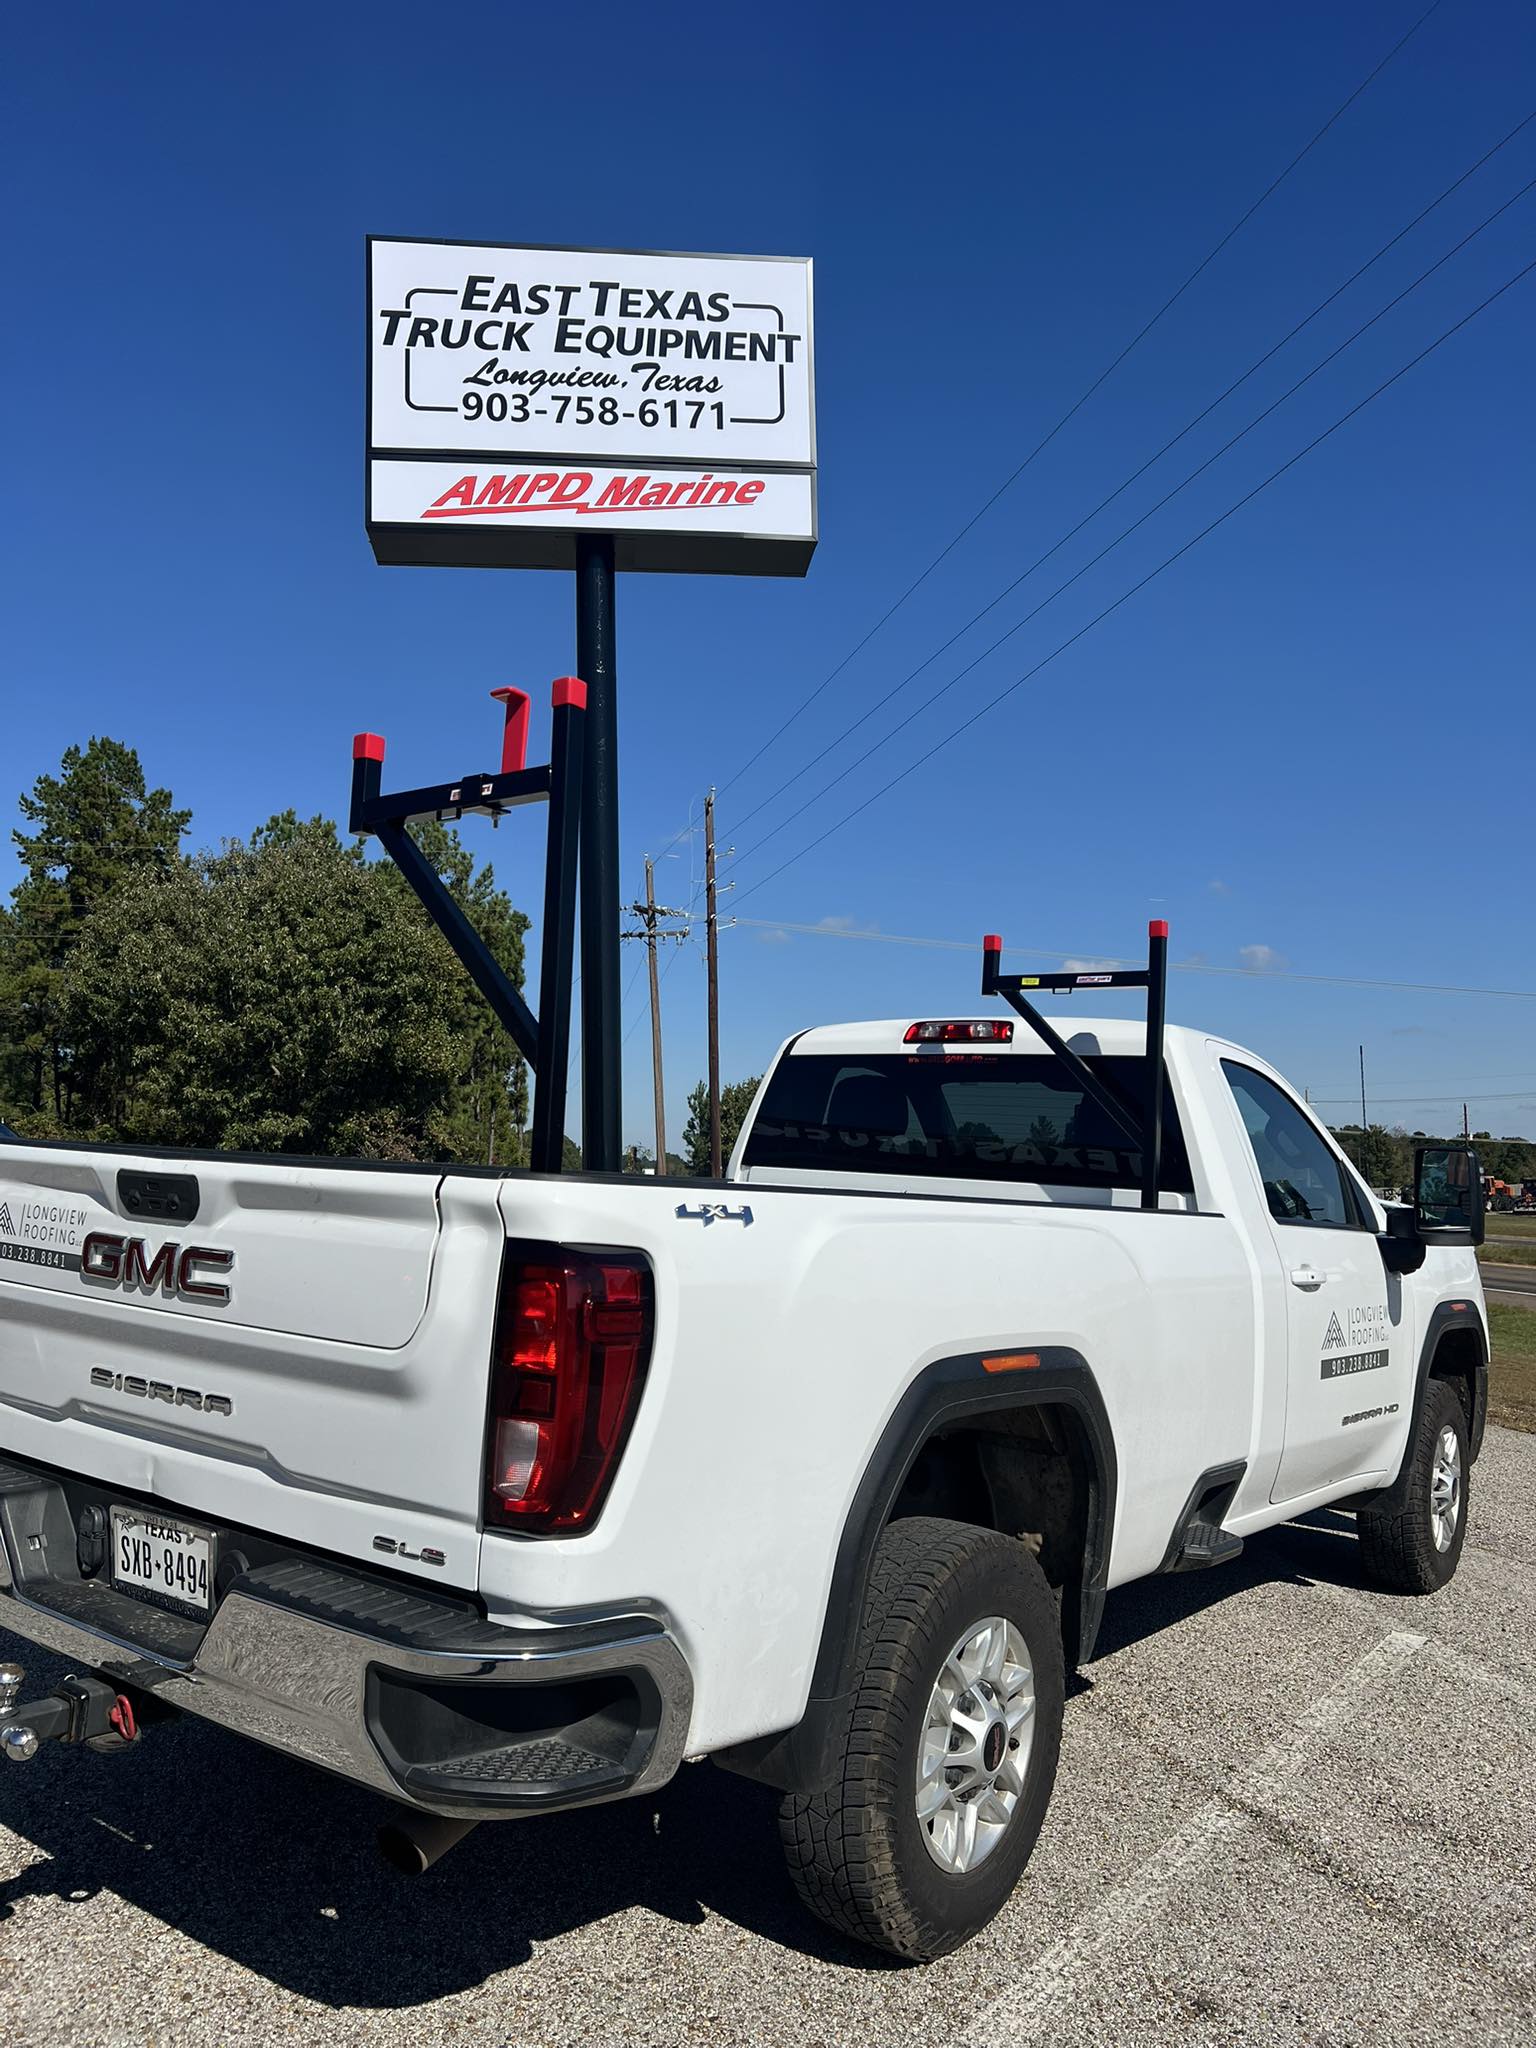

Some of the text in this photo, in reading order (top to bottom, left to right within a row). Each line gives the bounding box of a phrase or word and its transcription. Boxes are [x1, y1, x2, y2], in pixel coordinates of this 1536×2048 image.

[460, 275, 730, 323] EAST TEXAS
[379, 309, 801, 363] TRUCK EQUIPMENT
[630, 361, 723, 394] Texas
[461, 392, 725, 430] 903-758-6171
[430, 472, 766, 507] AMPD Marine
[26, 1204, 88, 1227] LONGVIEW
[24, 1223, 76, 1246] ROOFING
[0, 1244, 65, 1268] 03.238.8841
[82, 1231, 235, 1301] GMC
[1351, 1326, 1385, 1346] ROOFING
[90, 1367, 233, 1416] SIERRA
[1383, 1403, 1399, 1415] HD
[143, 1521, 182, 1544] TEXAS
